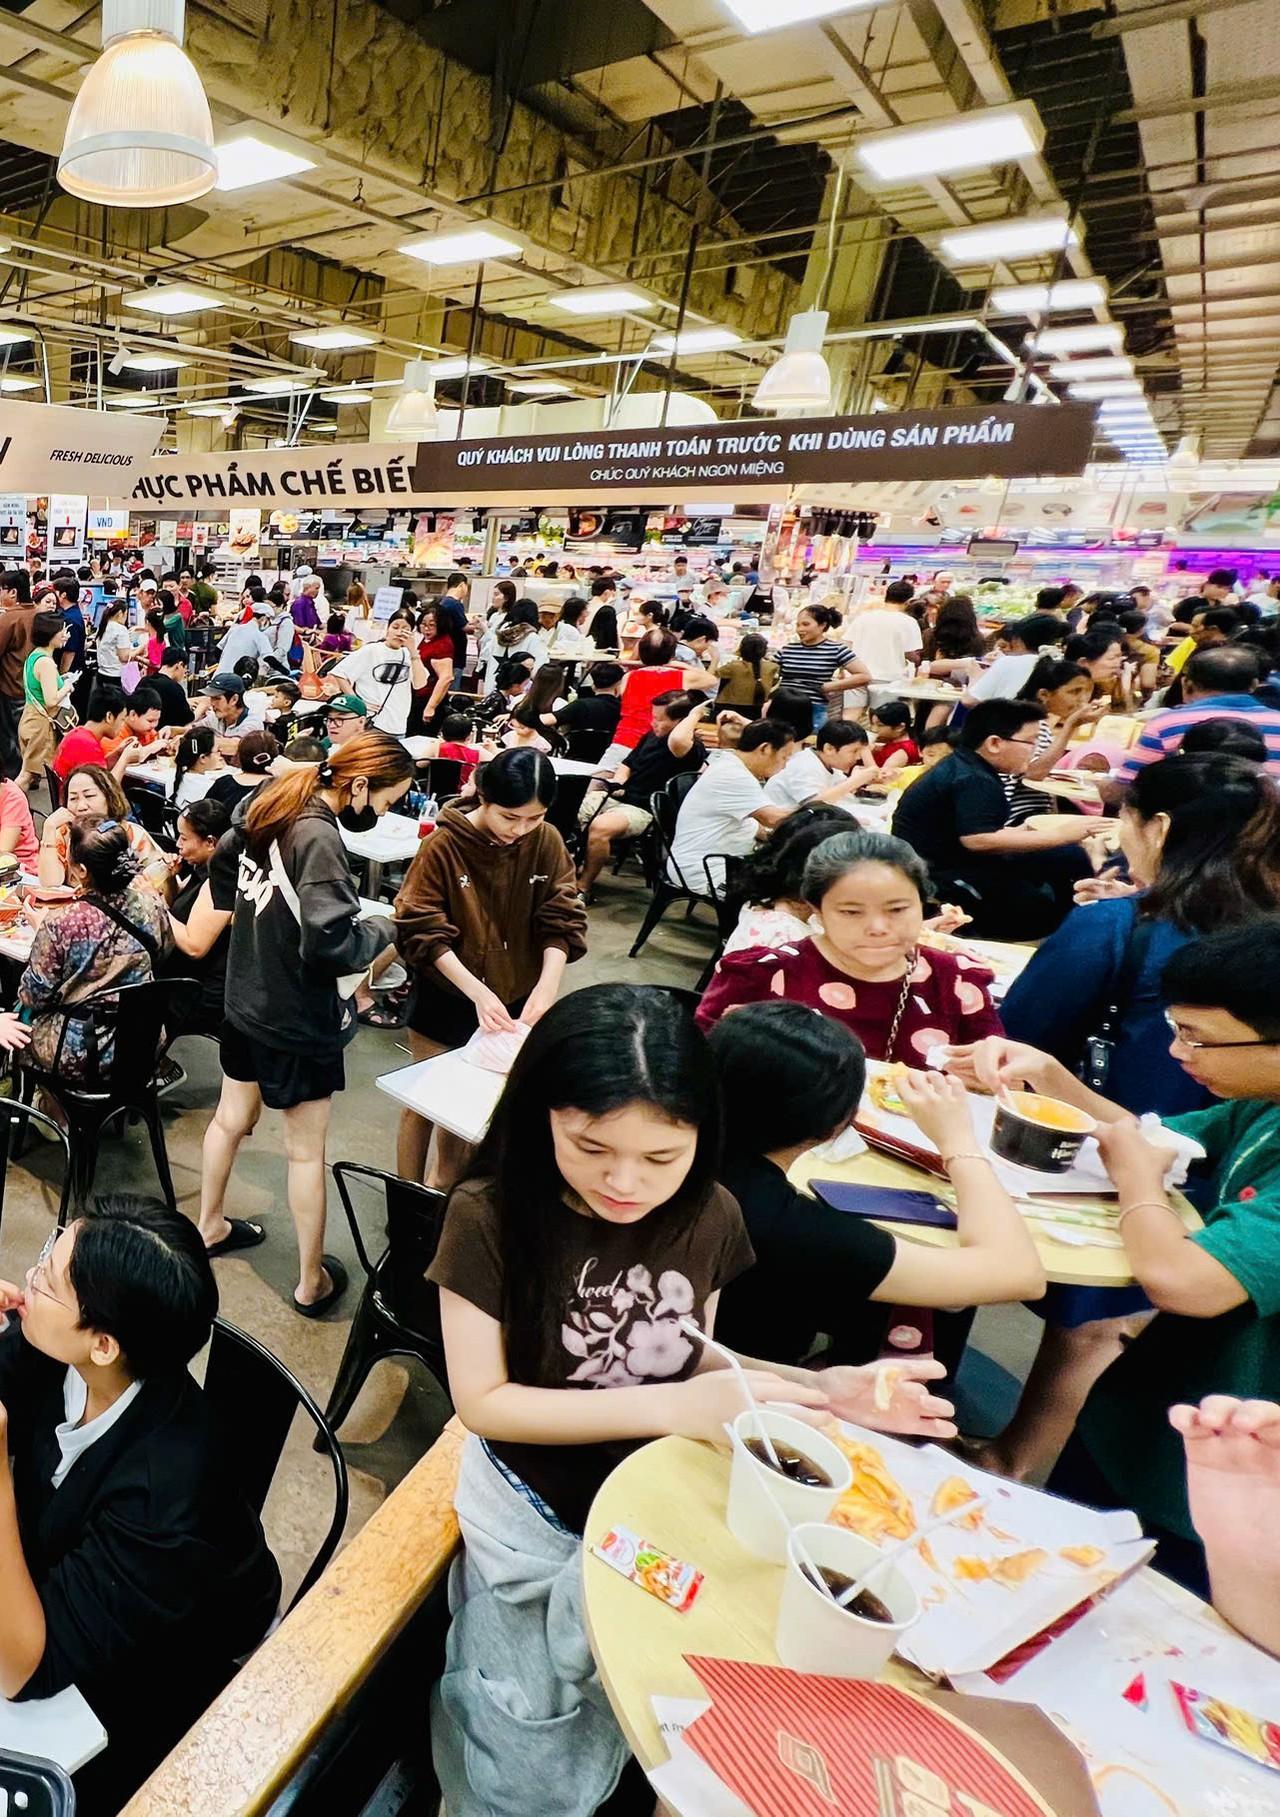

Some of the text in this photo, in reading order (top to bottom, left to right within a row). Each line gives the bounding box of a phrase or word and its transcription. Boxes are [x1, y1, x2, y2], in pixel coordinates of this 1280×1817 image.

[49, 449, 133, 466] FRESH DELICIOUS
[457, 449, 485, 467] QUÝ
[486, 444, 534, 465] KHÁCH
[537, 445, 562, 463] VUI
[563, 442, 605, 461] LÒNG
[607, 441, 661, 459] THANH
[665, 437, 712, 457] TOÁN
[715, 433, 782, 455] TRƯỚC
[788, 432, 823, 451] KHI
[827, 426, 887, 450] DÙNG
[942, 415, 1015, 445] PHẨM
[123, 473, 183, 504] HỰC
[185, 462, 276, 498] PHẨM
[280, 458, 347, 495] CHẾ
[590, 460, 785, 482] CHÚC QUÝ KHÁCH NGON MIỆNG
